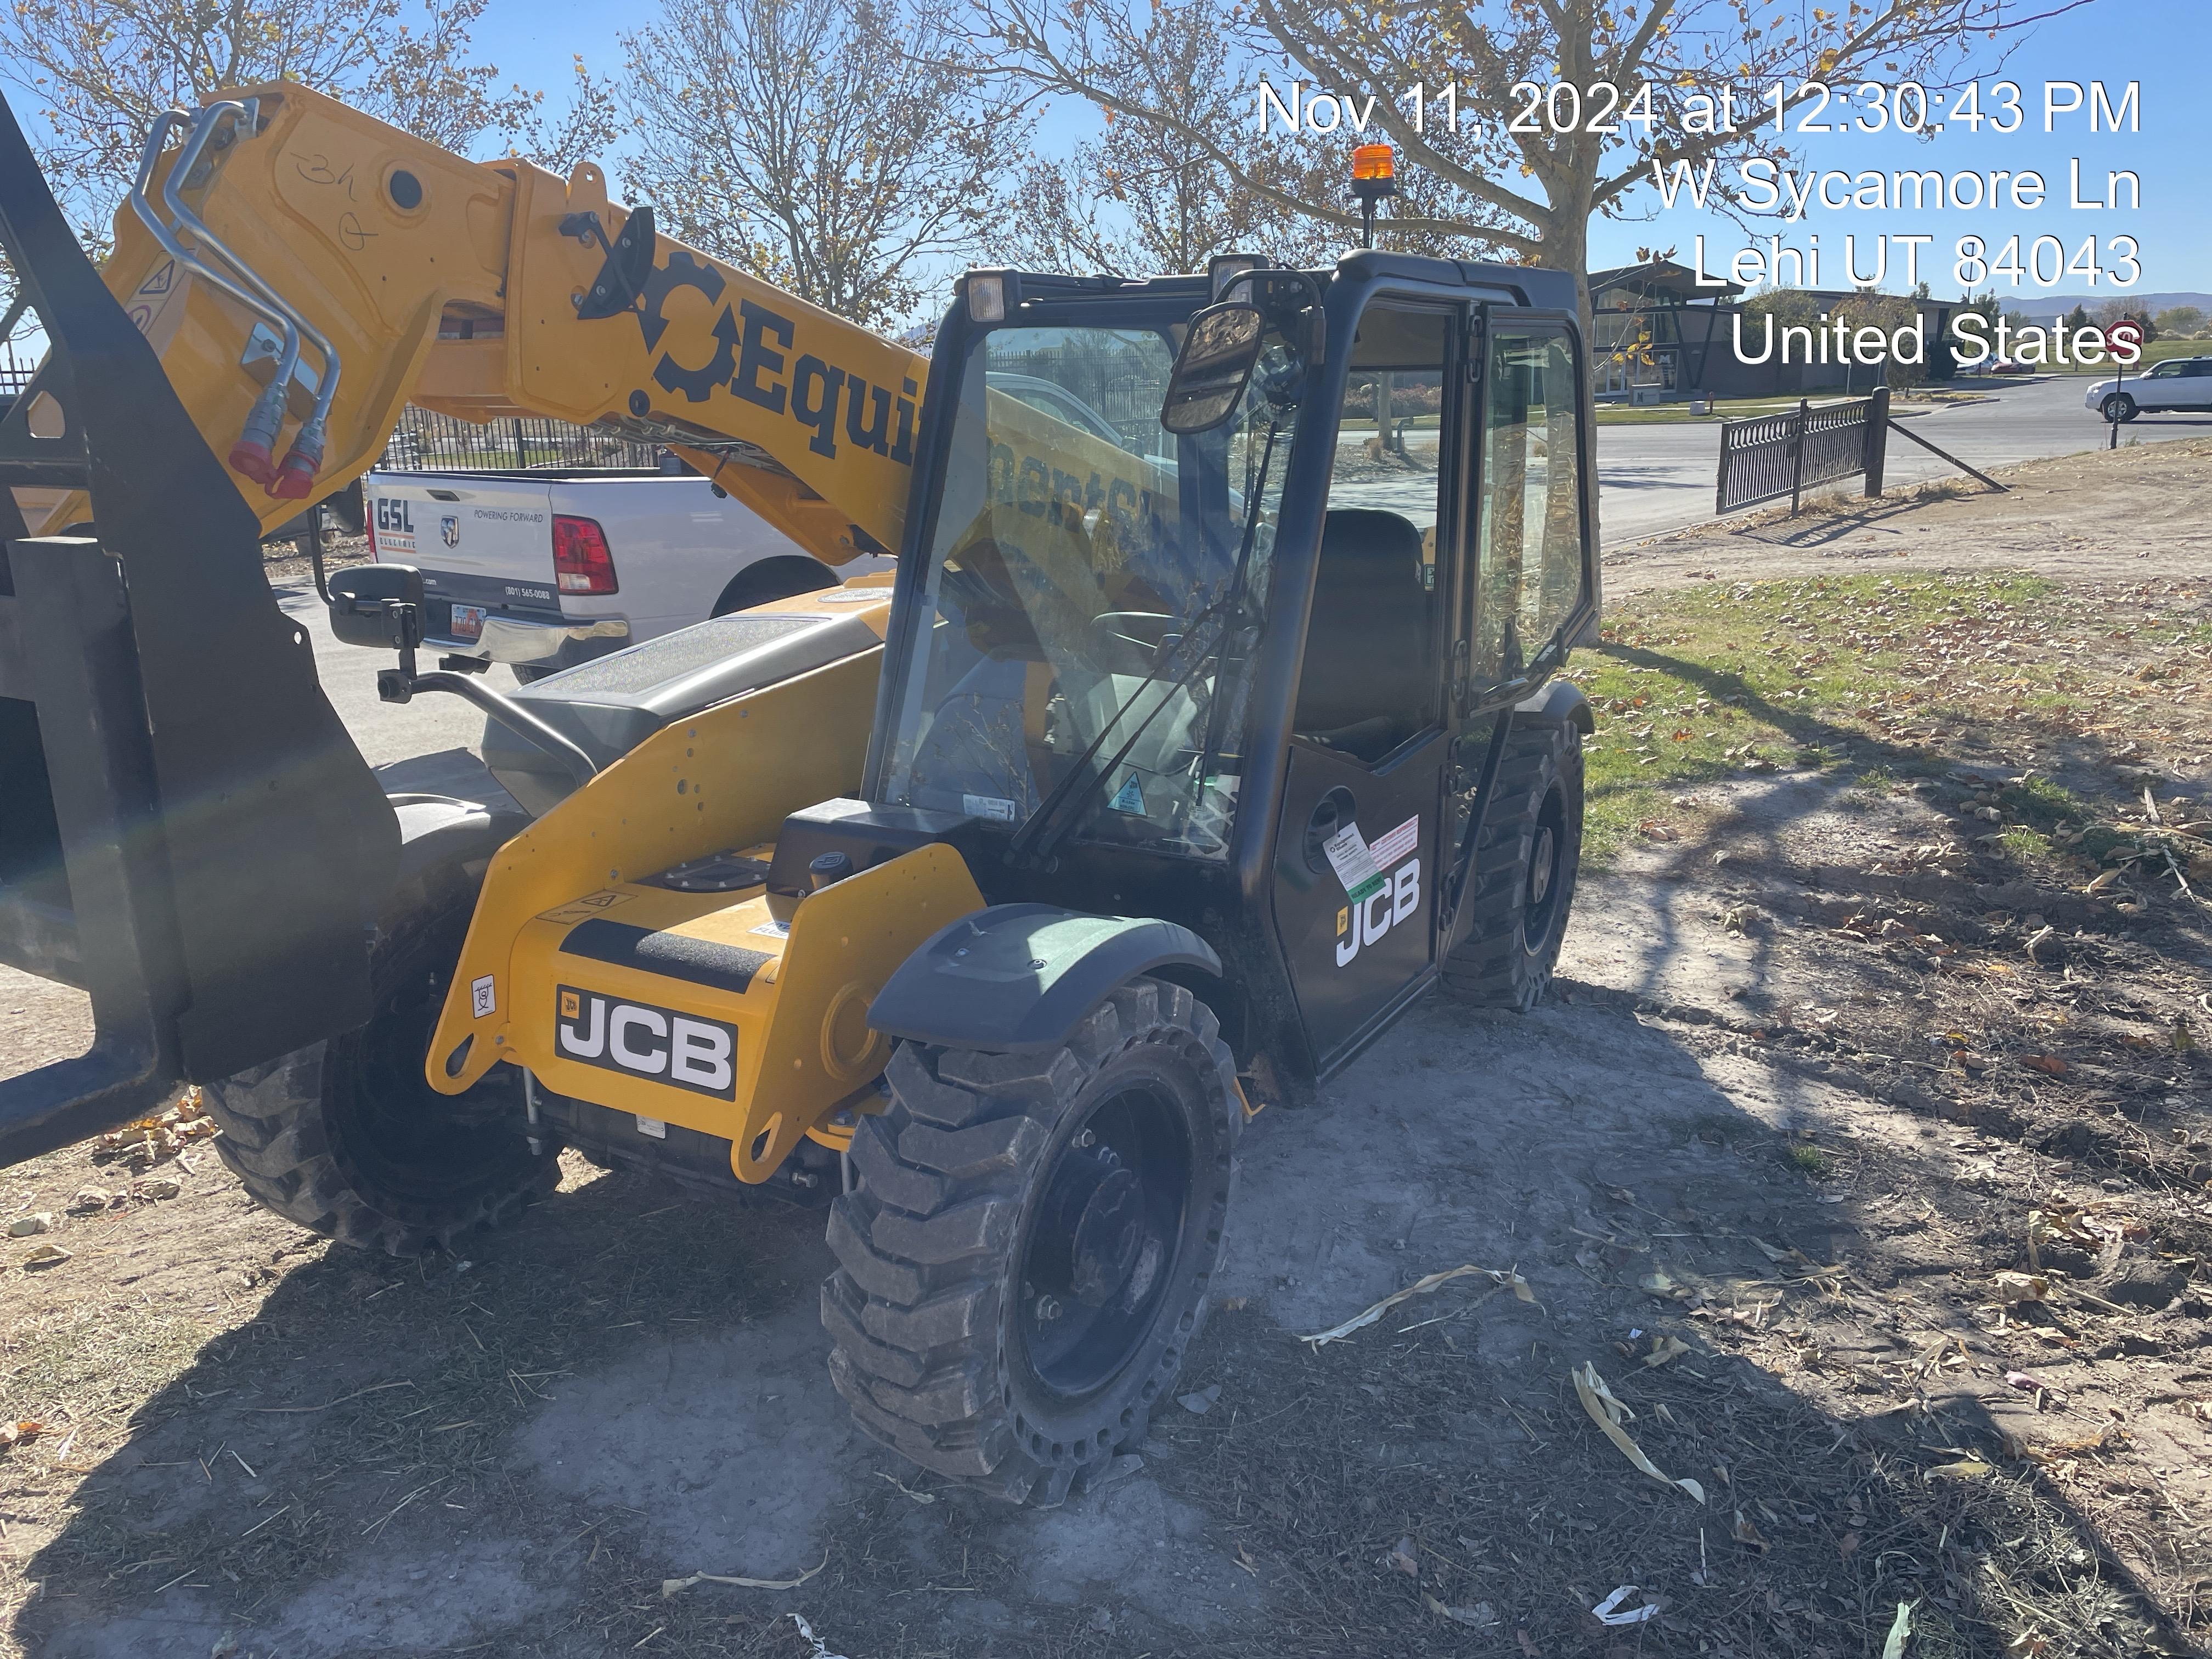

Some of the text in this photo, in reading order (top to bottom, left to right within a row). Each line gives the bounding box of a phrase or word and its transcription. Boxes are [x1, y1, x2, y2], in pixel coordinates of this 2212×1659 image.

[730, 298, 924, 467] Equi
[377, 498, 414, 533] GSL
[474, 509, 543, 523] POWERING FORWARD
[505, 586, 521, 597] (801)
[1351, 887, 1366, 899] READY
[1336, 858, 1420, 967] JCB
[754, 927, 788, 936] FLUID
[566, 997, 577, 1011] JCB
[560, 997, 732, 1090] JCB
